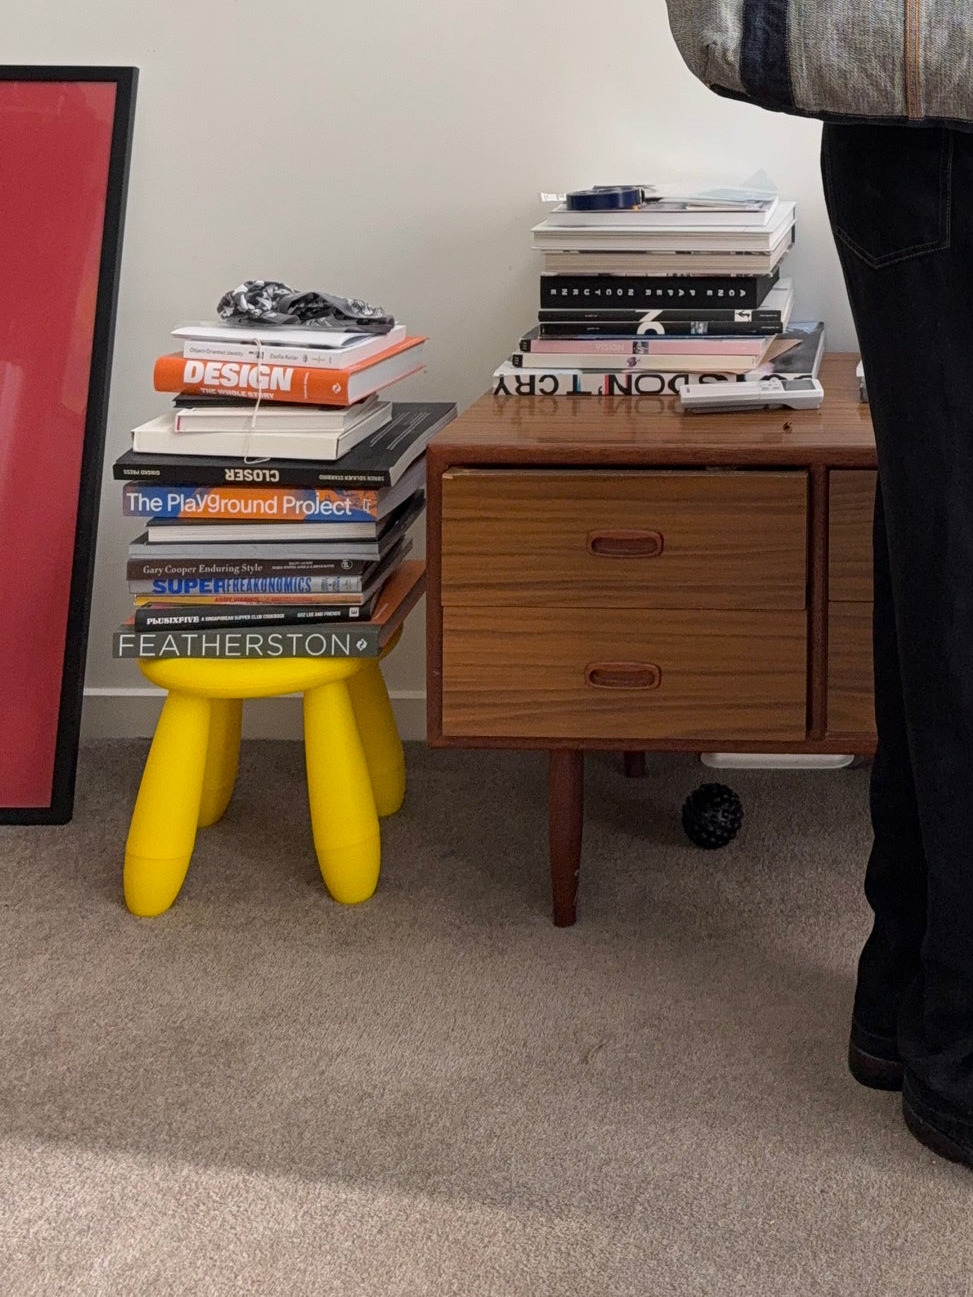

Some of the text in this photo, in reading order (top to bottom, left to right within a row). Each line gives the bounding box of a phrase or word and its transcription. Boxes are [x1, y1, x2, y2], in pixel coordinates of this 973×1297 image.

[550, 288, 746, 297] ACNE PAPER NOCTURNE
[183, 360, 294, 392] DESIGN
[493, 374, 558, 396] CRY
[566, 374, 691, 396] DON'T
[200, 387, 217, 395] THE
[217, 389, 247, 397] WHOLE
[225, 468, 280, 482] CLOSER
[126, 492, 352, 516] The Playground Project
[143, 565, 164, 576] Gary
[164, 565, 196, 575] Cooper
[199, 564, 239, 574] Enduring
[241, 563, 263, 574] Style
[152, 577, 312, 595] SUPERFREAKONOMICS
[118, 634, 350, 657] FEATHERSTON
